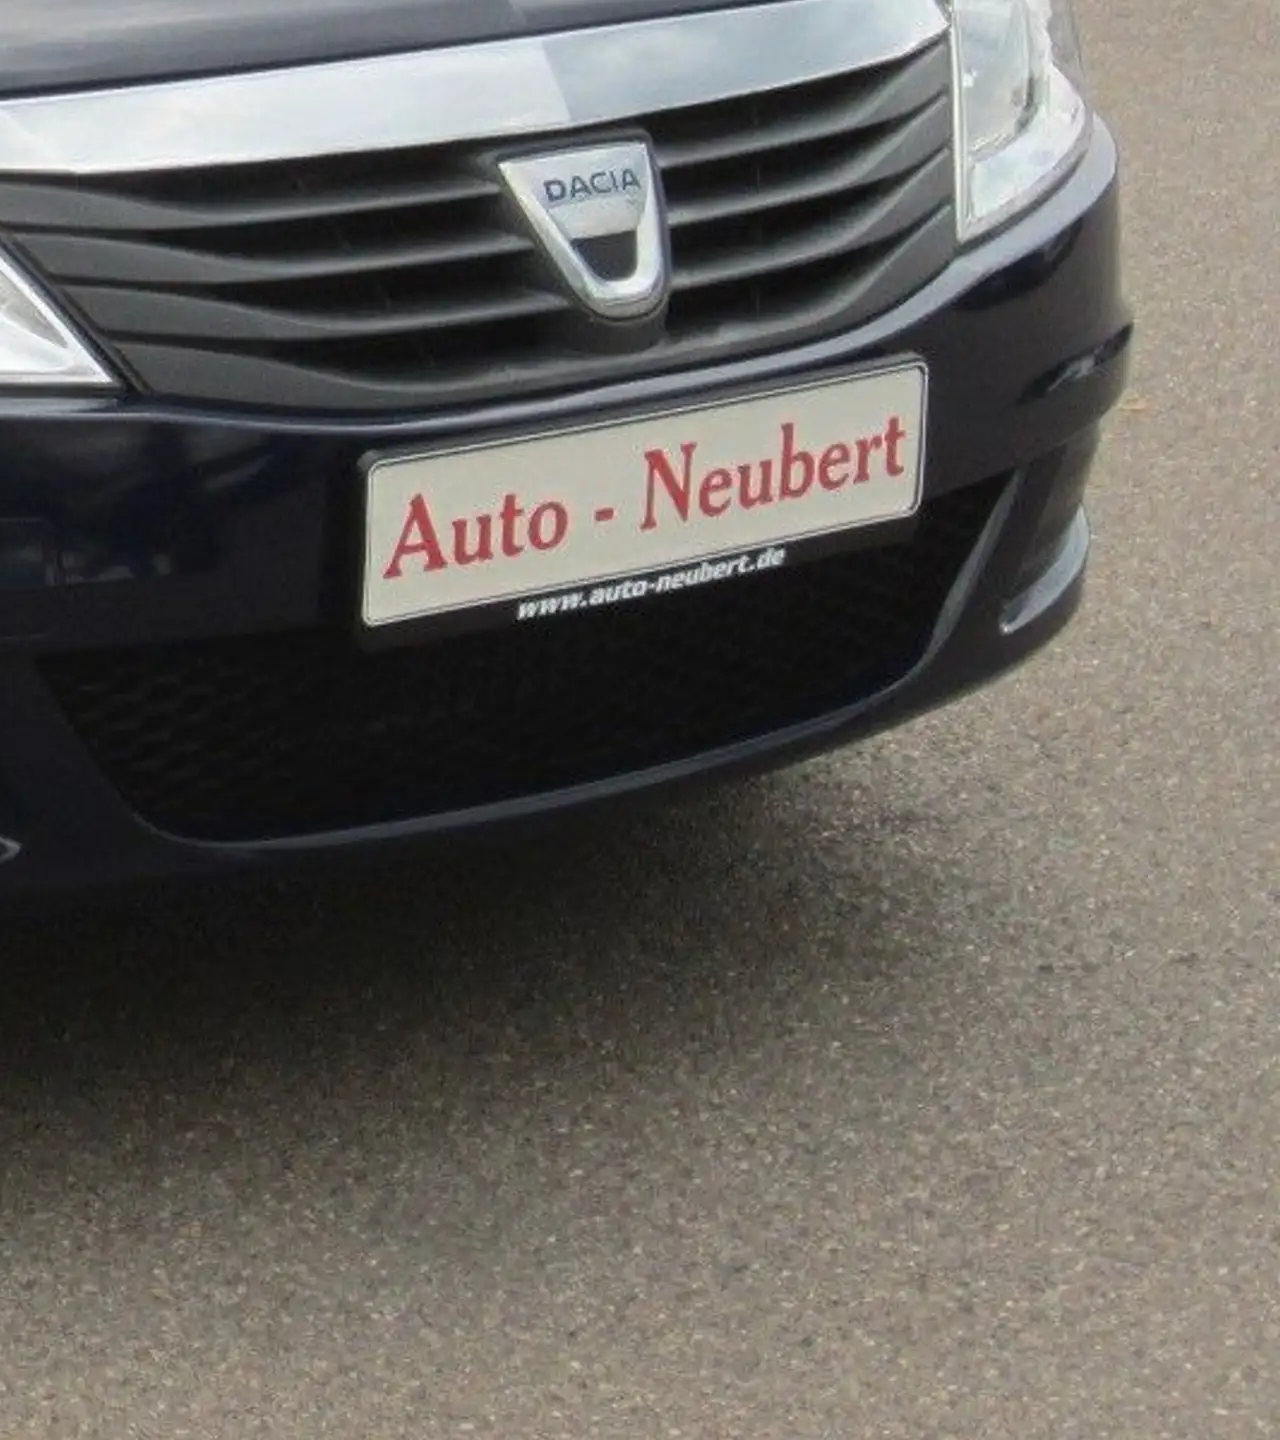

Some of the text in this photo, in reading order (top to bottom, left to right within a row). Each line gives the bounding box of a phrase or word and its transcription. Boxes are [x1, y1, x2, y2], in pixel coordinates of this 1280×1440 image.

[544, 168, 640, 202] DACIA
[383, 493, 570, 579] Auto
[640, 416, 907, 531] Neubert
[516, 547, 786, 620] www.auto-neubert.de
